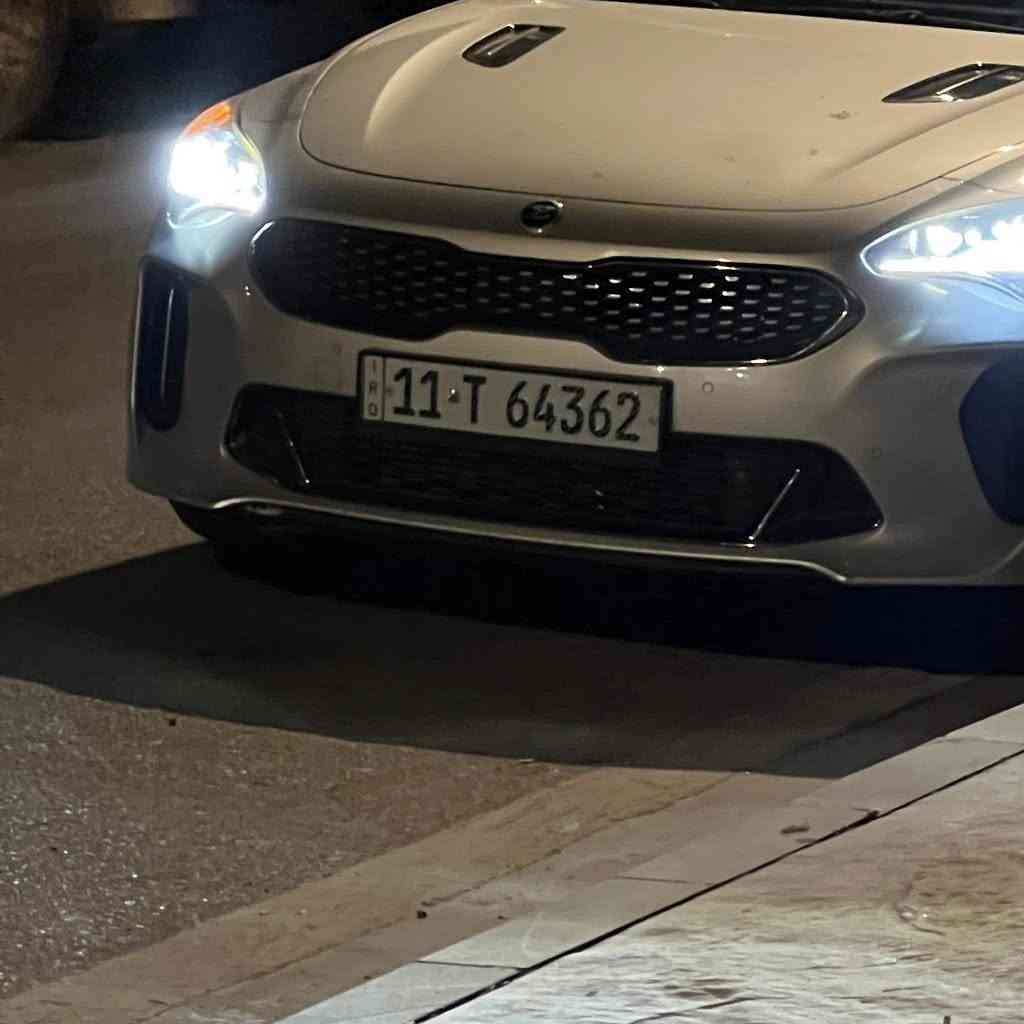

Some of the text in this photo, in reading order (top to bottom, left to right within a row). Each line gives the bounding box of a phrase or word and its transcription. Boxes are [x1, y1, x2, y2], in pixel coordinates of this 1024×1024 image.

[393, 367, 641, 442] 11 T 64362
